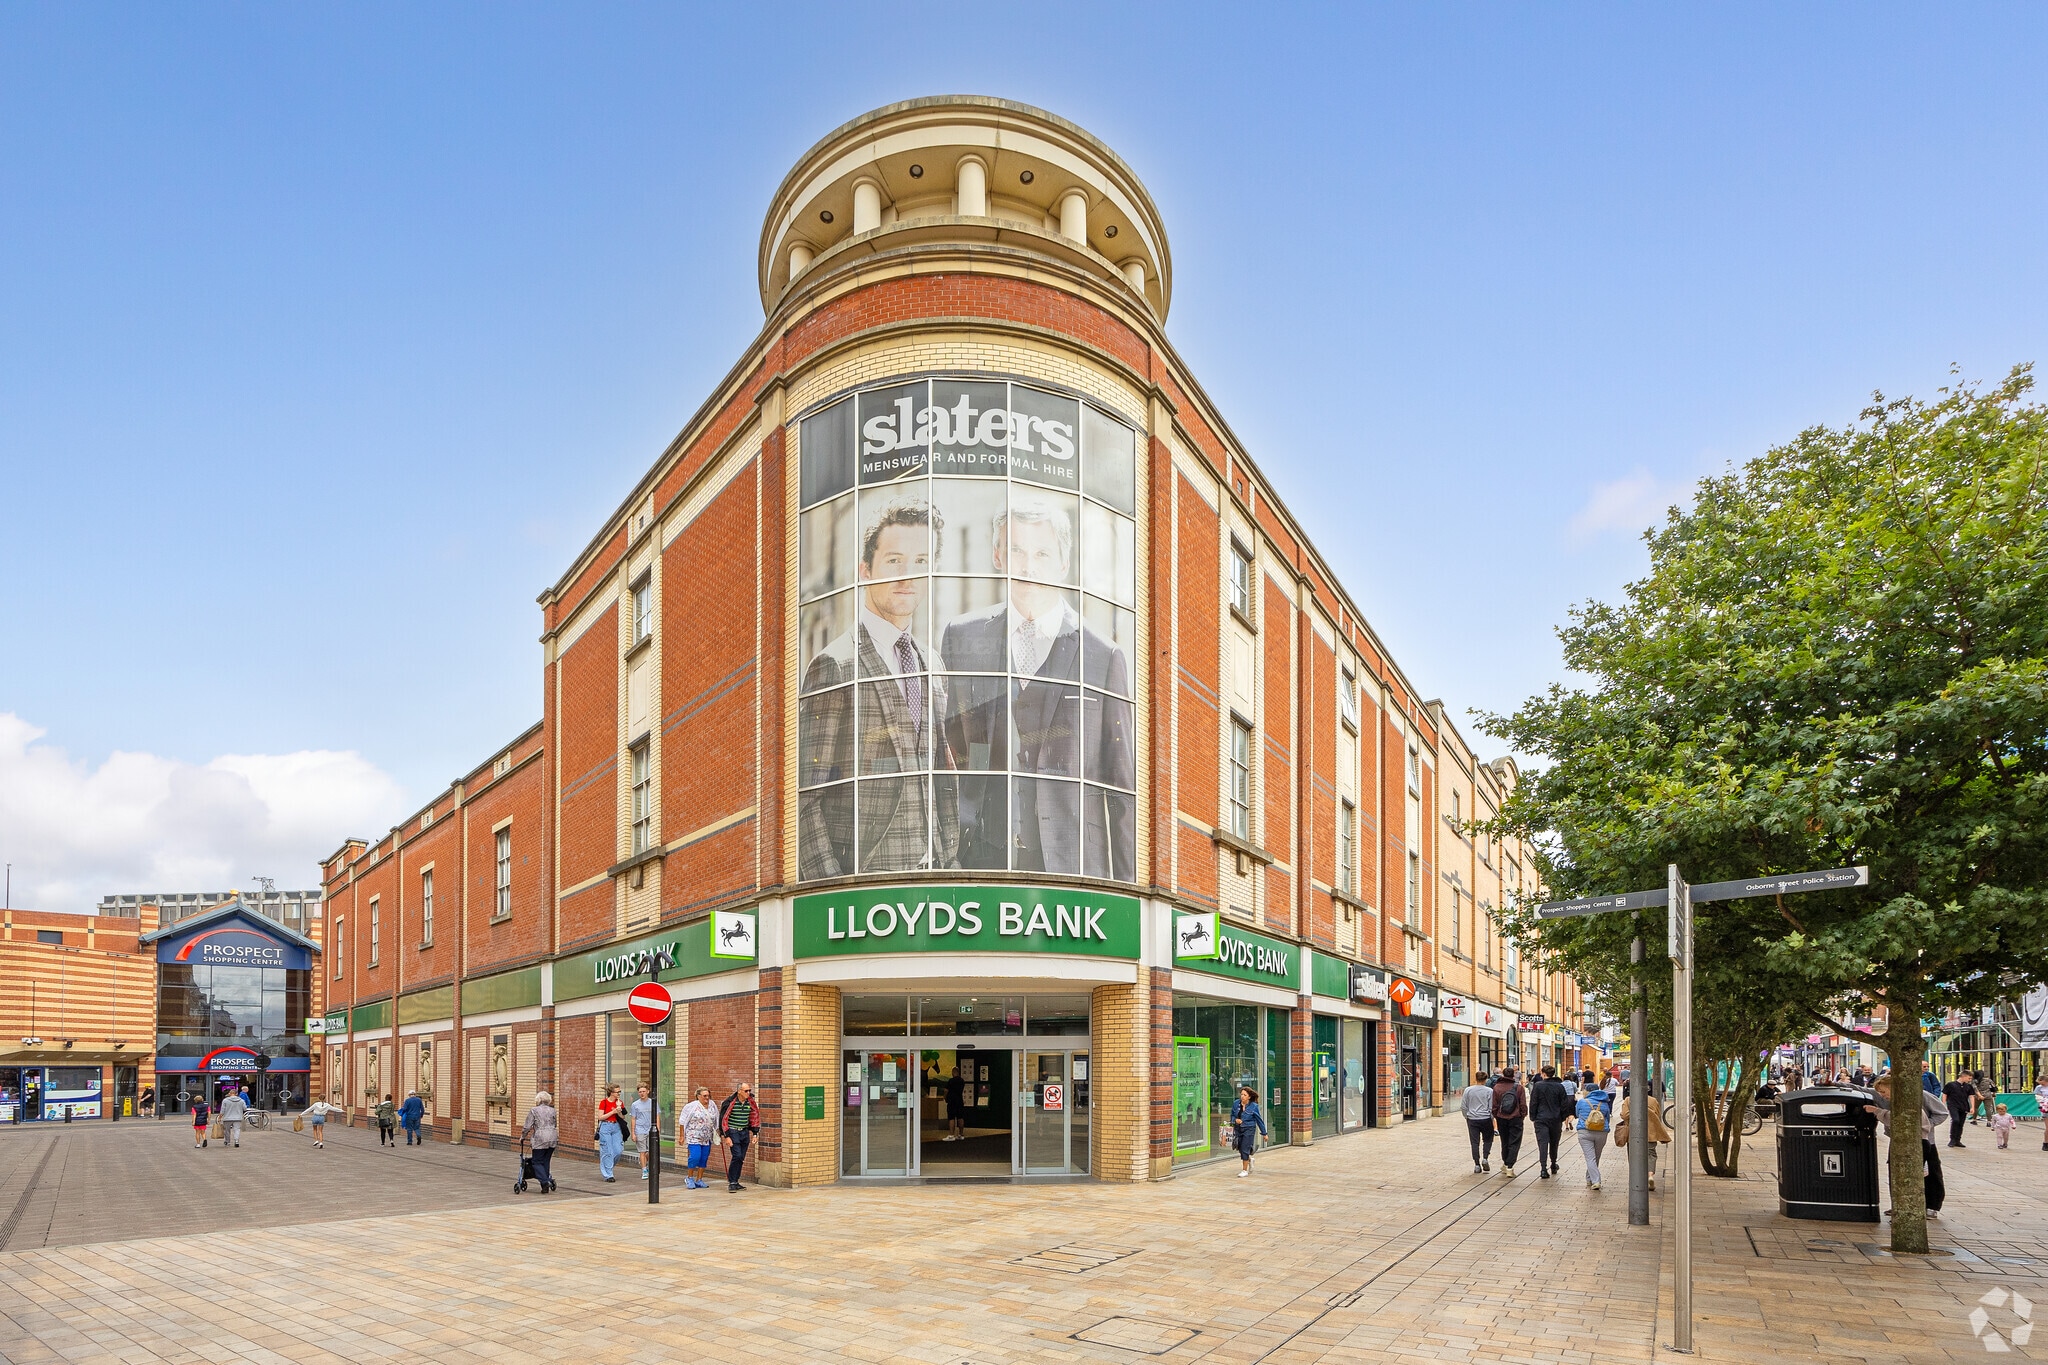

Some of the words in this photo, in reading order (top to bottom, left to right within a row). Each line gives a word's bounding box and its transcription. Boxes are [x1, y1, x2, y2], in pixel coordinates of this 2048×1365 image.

[863, 394, 1075, 460] slaters
[863, 452, 941, 474] MENSWEAR
[947, 453, 976, 464] AND
[980, 453, 1038, 471] FORMAL
[1043, 463, 1074, 479] HIRE
[1745, 882, 1775, 891] Osborne
[1778, 880, 1799, 888] Street
[1803, 877, 1824, 885] Police
[1827, 873, 1855, 883] Station
[1541, 905, 1564, 914] Prospect
[1566, 903, 1591, 911] Shopping
[828, 901, 983, 940] LLOYDS
[999, 902, 1107, 940] BANK
[203, 944, 283, 959] PROSPECT
[1214, 935, 1254, 967] OYDS
[1257, 945, 1289, 976] BANK
[203, 956, 248, 964] SHOPPING
[251, 958, 283, 966] CENTRE
[594, 952, 636, 984] LLOYDS
[1519, 1014, 1544, 1022] Scotts
[1518, 1022, 1544, 1031] LET
[210, 1058, 255, 1066] PROSPEC
